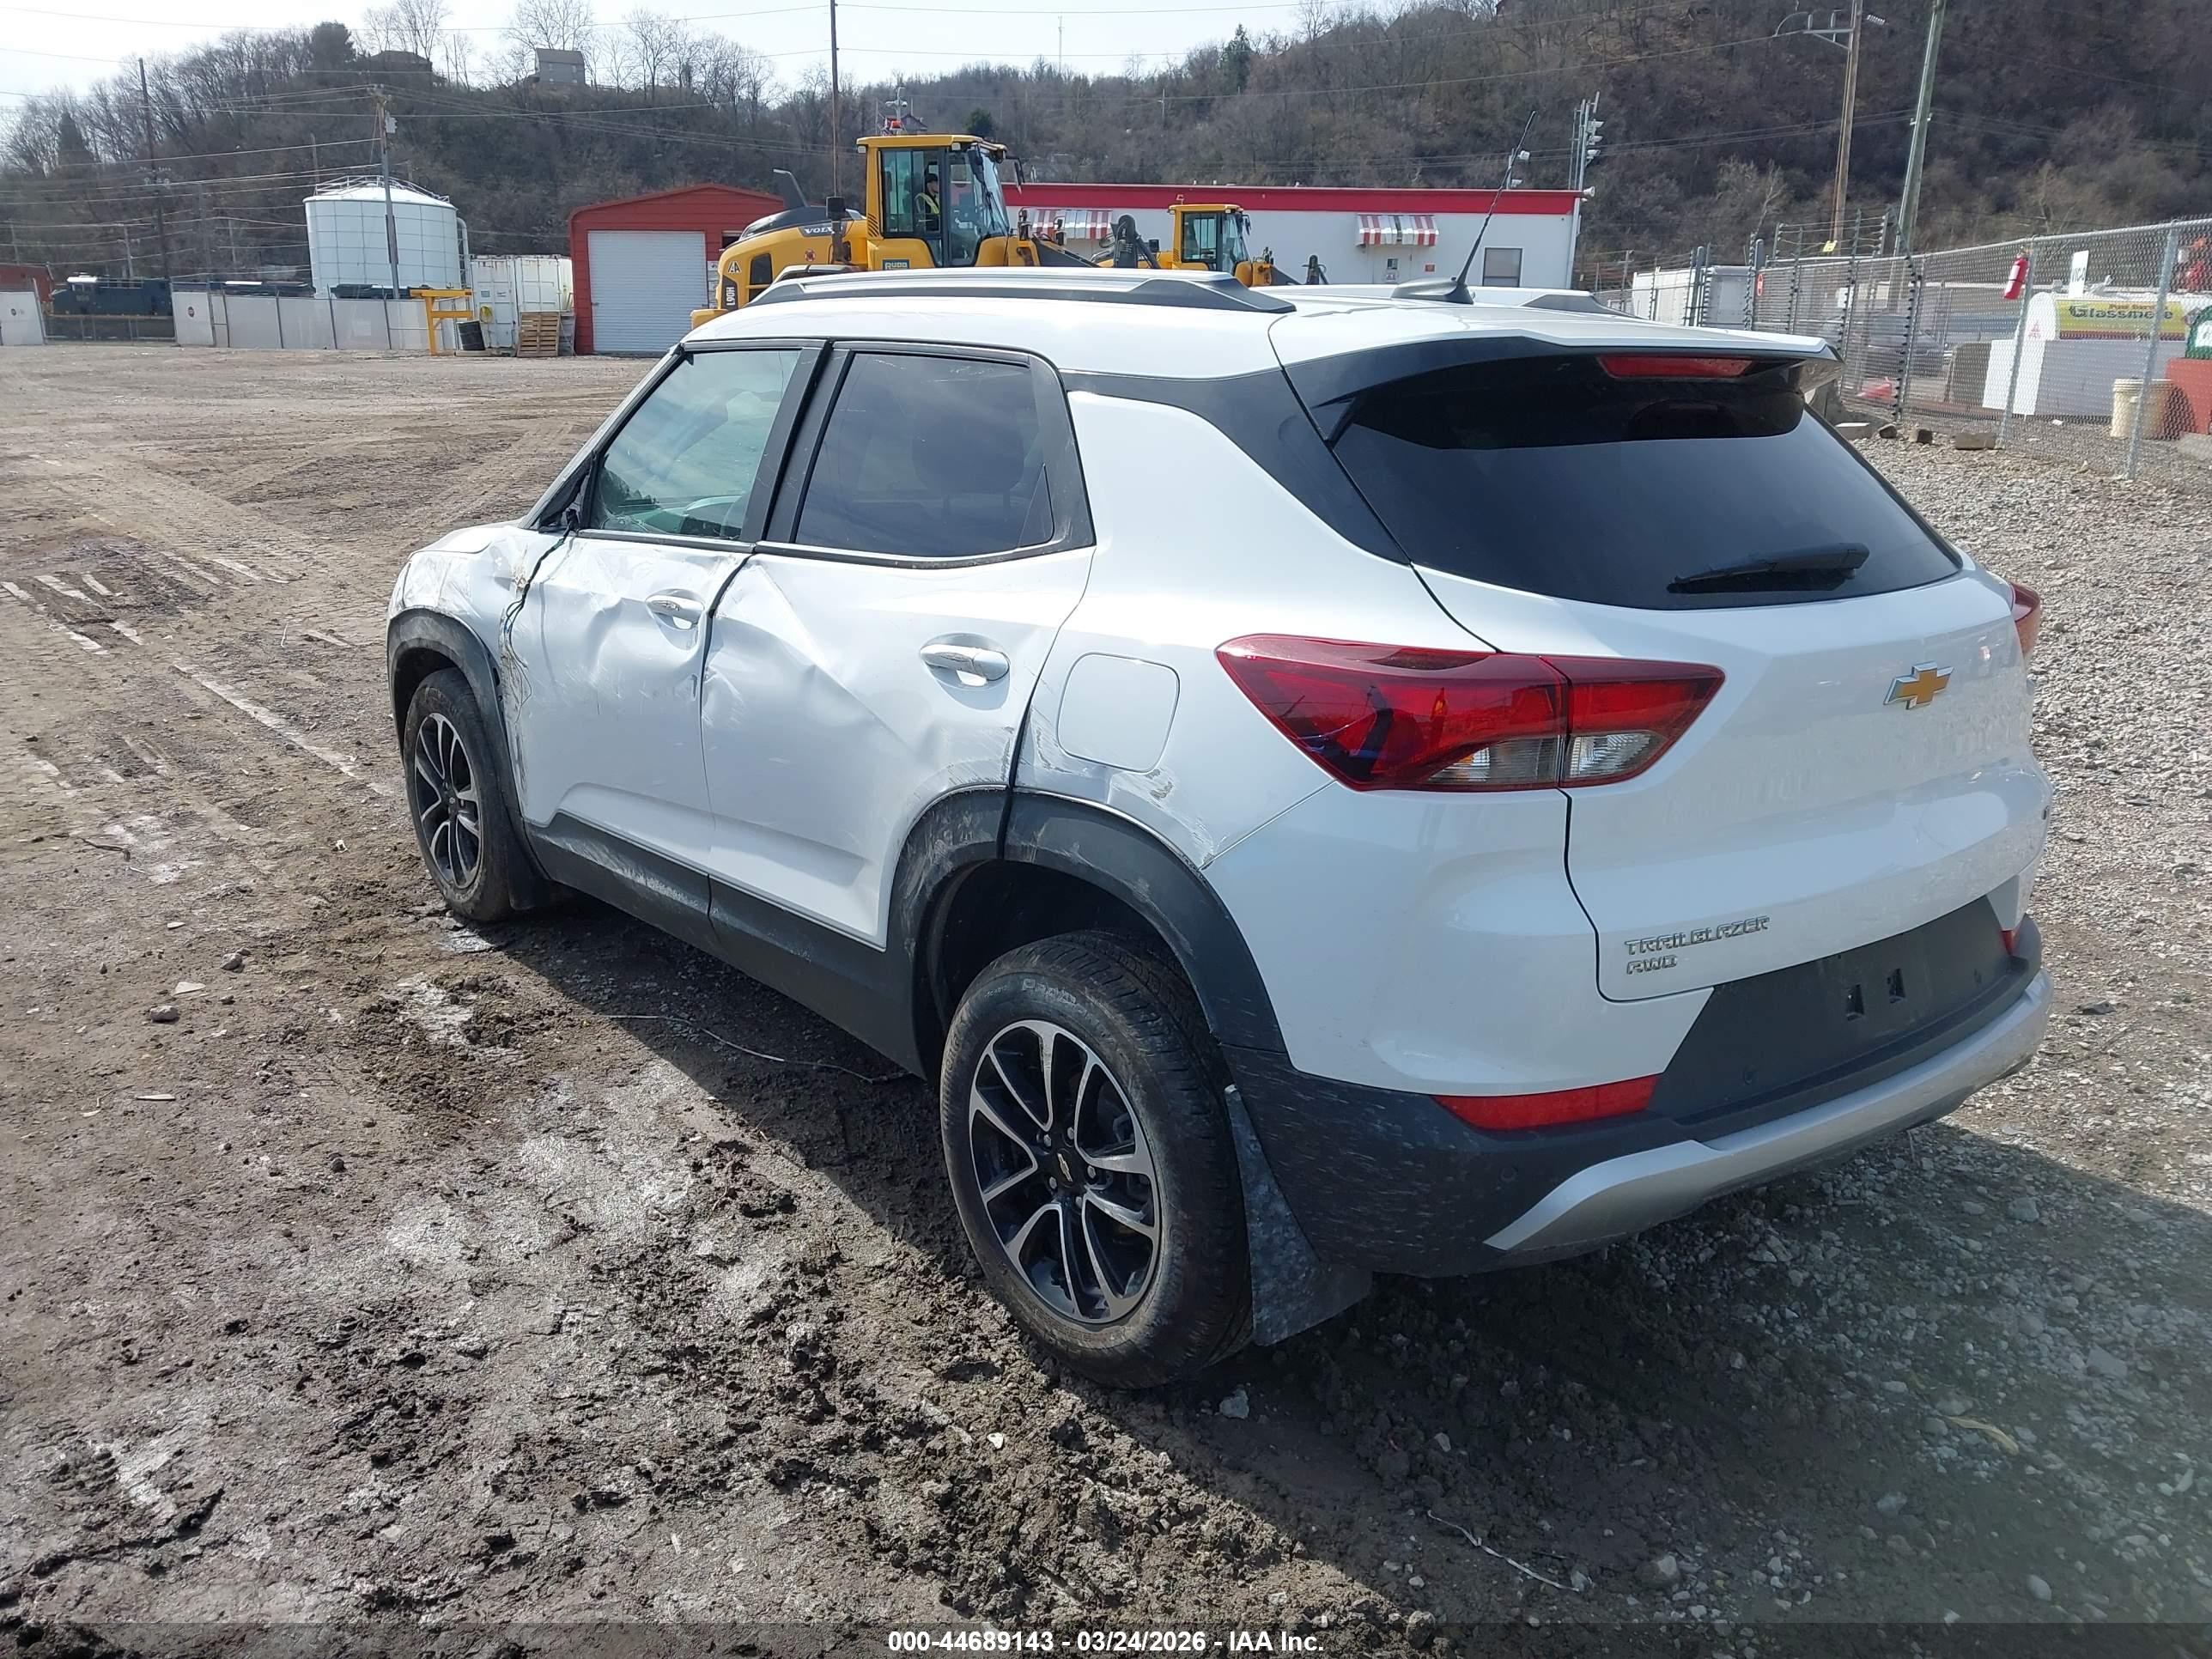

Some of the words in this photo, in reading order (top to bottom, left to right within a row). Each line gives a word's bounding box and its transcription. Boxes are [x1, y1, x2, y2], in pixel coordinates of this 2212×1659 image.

[804, 225, 842, 234] VOLV
[726, 286, 735, 306] L90H
[2069, 304, 2172, 319] Glassmee
[1625, 915, 1770, 956] TRAILBLAZER
[1626, 954, 1679, 975] AWD
